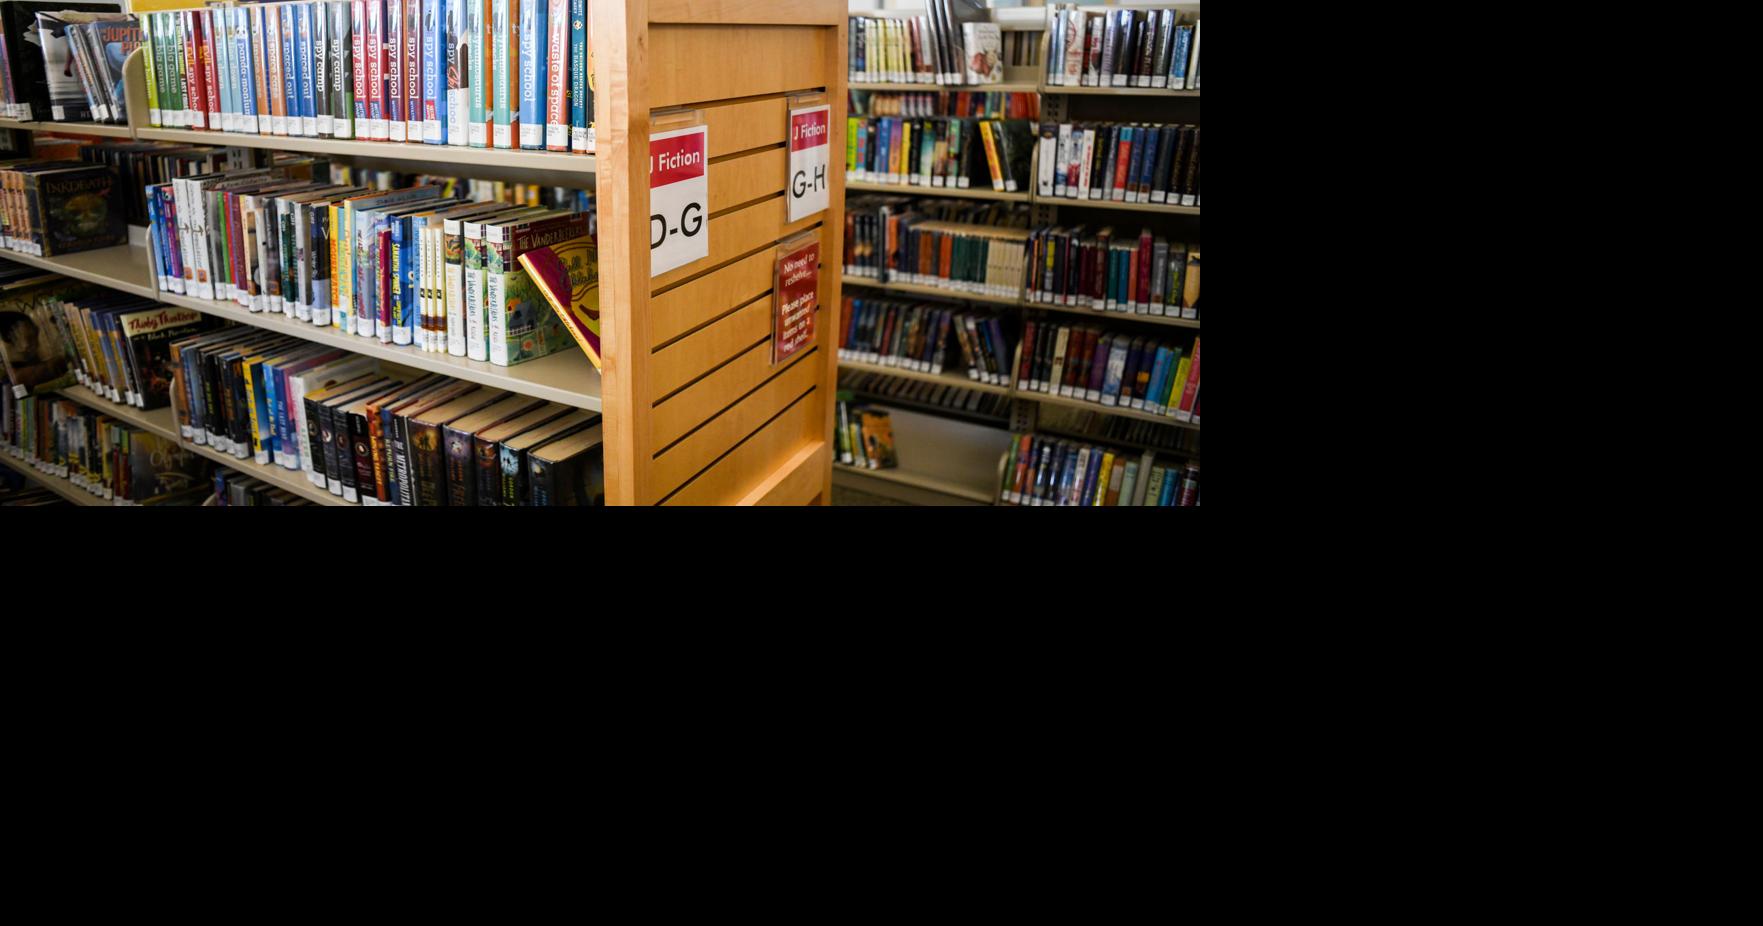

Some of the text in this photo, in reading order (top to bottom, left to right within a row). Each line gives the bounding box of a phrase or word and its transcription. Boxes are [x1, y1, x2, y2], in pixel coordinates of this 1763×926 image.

[315, 40, 323, 60] spy
[332, 40, 340, 59] spy
[168, 64, 177, 94] game
[354, 39, 365, 98] spy school
[369, 39, 378, 99] spy school
[389, 38, 399, 98] spy school
[408, 37, 418, 99] spy school
[424, 36, 436, 99] spy school
[522, 33, 535, 102] spy school
[549, 33, 562, 127] waste of space
[190, 86, 199, 112] schoo
[207, 85, 215, 112] schoo
[449, 91, 458, 125] schoo
[794, 122, 826, 140] J Fiction
[659, 149, 700, 172] Fiction
[792, 164, 826, 199] G-H
[650, 202, 703, 250] D-G
